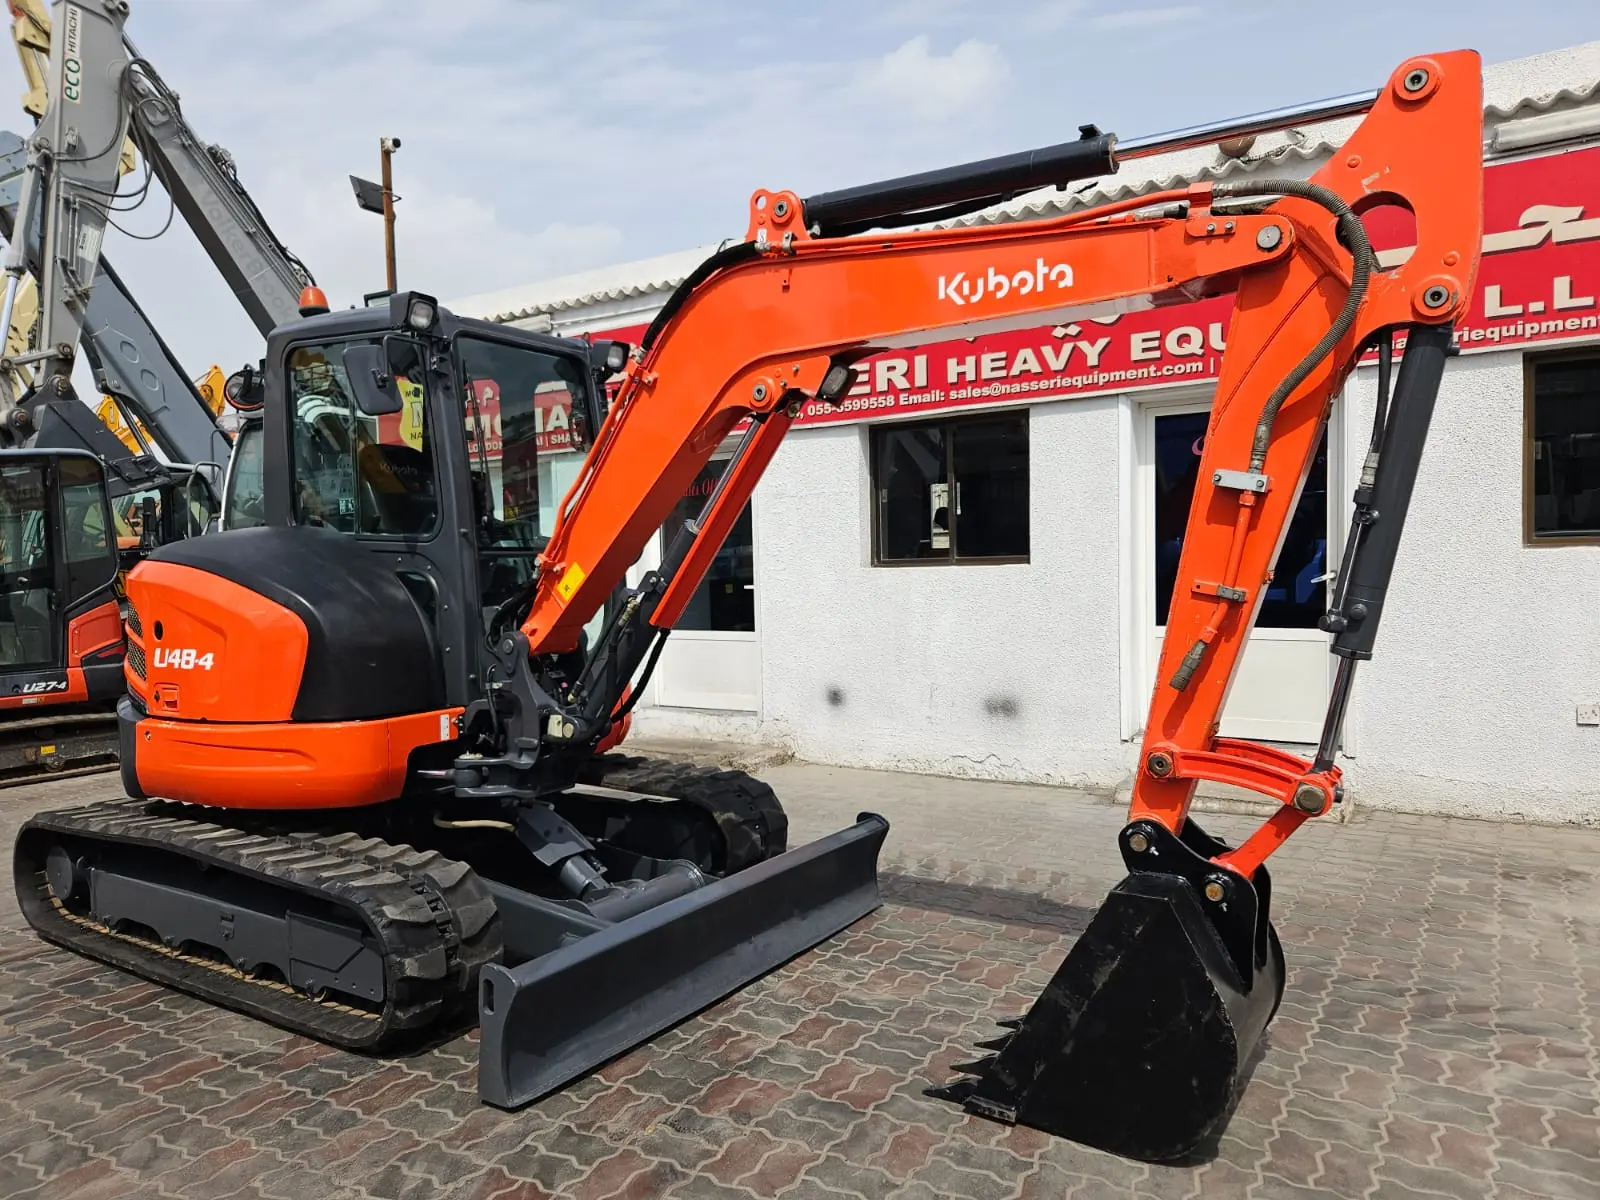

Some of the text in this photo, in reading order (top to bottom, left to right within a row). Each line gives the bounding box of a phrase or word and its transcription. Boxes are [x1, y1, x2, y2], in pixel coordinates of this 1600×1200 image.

[67, 8, 78, 53] HITACHI
[938, 257, 1074, 305] Kubota
[946, 336, 1111, 384] HEAVY
[899, 389, 945, 406] Email:
[949, 360, 1204, 400] sales@nasseriequipment.com
[468, 440, 502, 453] LODO
[153, 647, 215, 671] U48-4
[22, 680, 68, 693] U27-4
